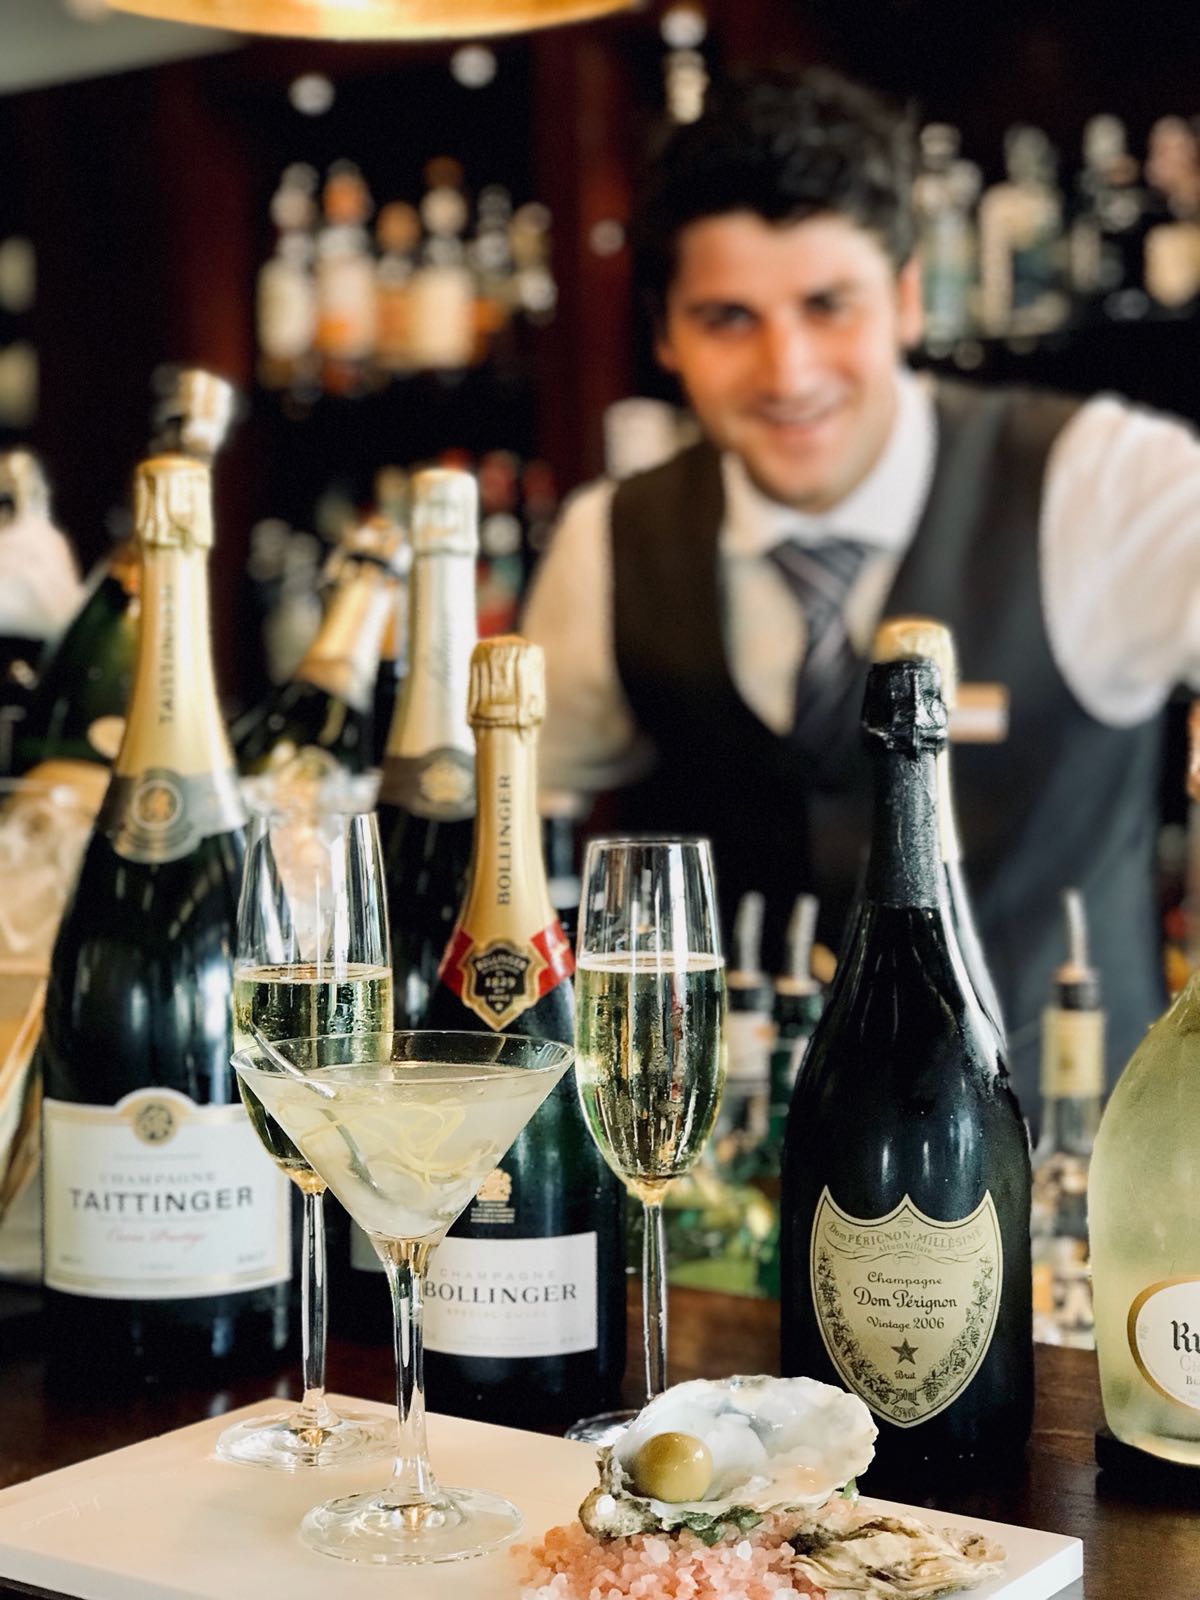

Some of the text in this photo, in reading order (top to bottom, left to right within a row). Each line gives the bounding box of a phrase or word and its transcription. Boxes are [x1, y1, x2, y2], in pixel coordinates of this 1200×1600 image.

[497, 774, 511, 905] BOLLINGER
[69, 1186, 255, 1213] TAITTINGER
[439, 1268, 558, 1281] CHAMPAGNE
[867, 1271, 943, 1289] Champagne
[424, 1280, 577, 1304] BOLLINGER
[853, 1286, 958, 1315] Dom Pérignon
[866, 1315, 945, 1333] Vintage 2006
[894, 1369, 917, 1380] Brut
